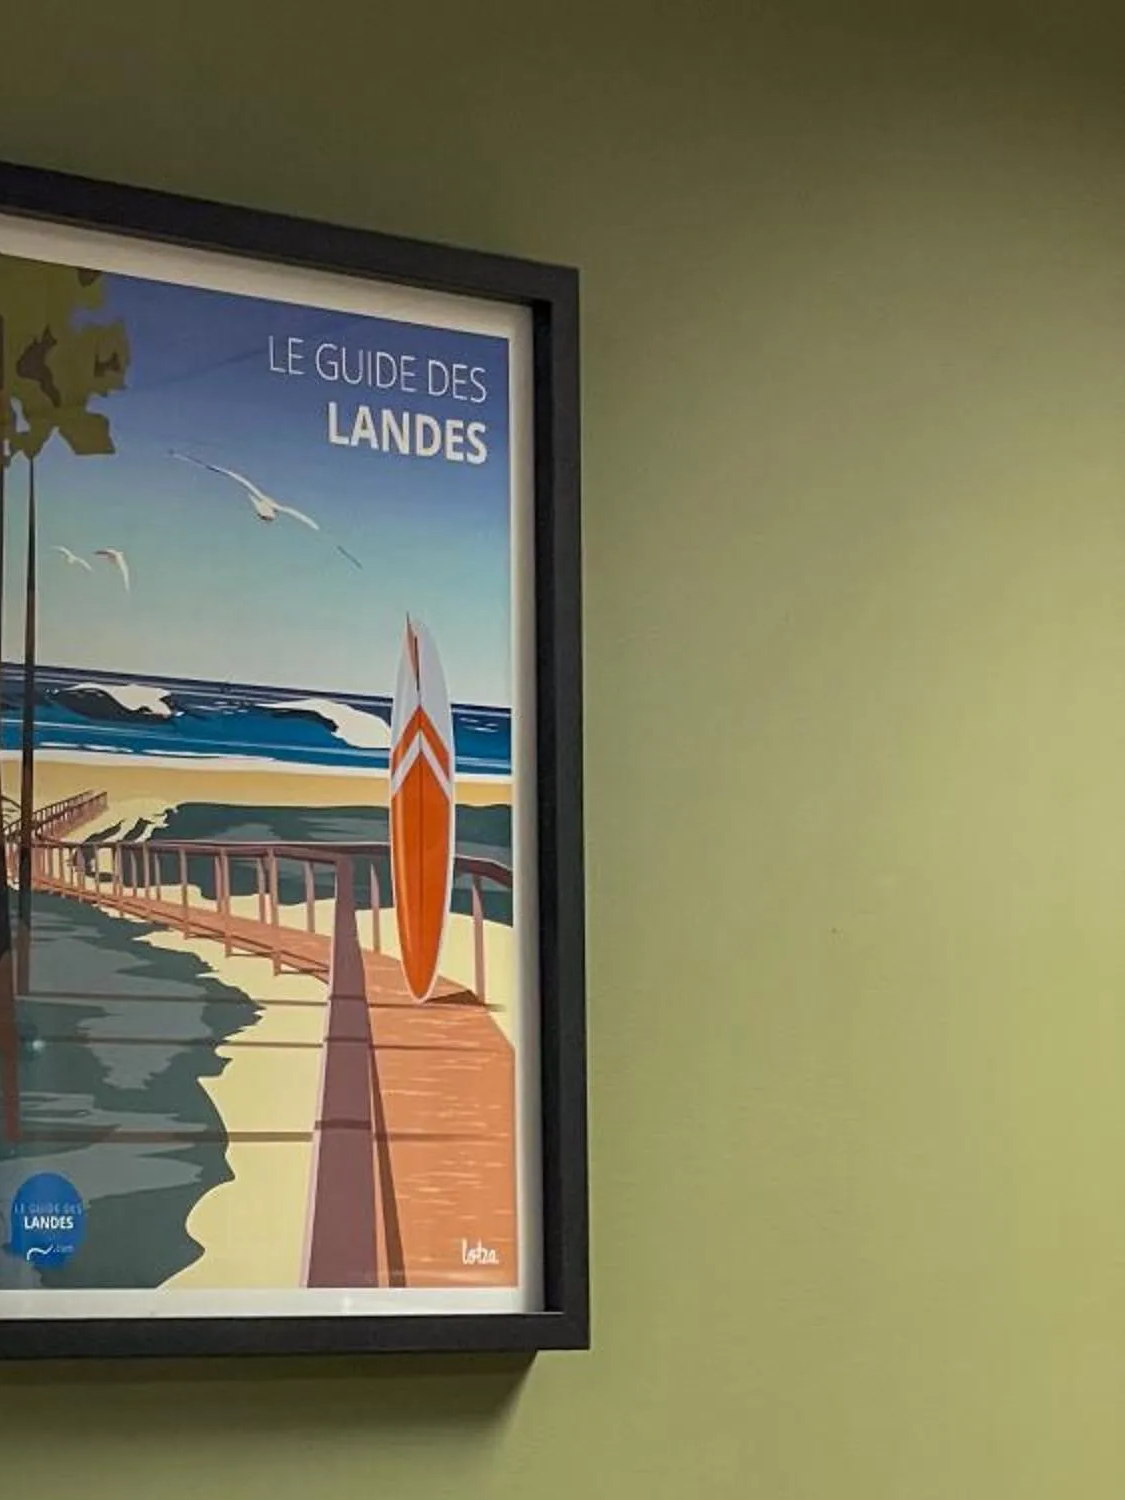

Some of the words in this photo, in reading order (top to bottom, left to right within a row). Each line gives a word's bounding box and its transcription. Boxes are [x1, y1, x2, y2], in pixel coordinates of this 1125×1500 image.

[268, 335, 305, 375] LE
[315, 343, 418, 392] GUIDE
[427, 359, 488, 404] DES
[328, 401, 488, 465] LANDES
[23, 1215, 74, 1230] LANDES
